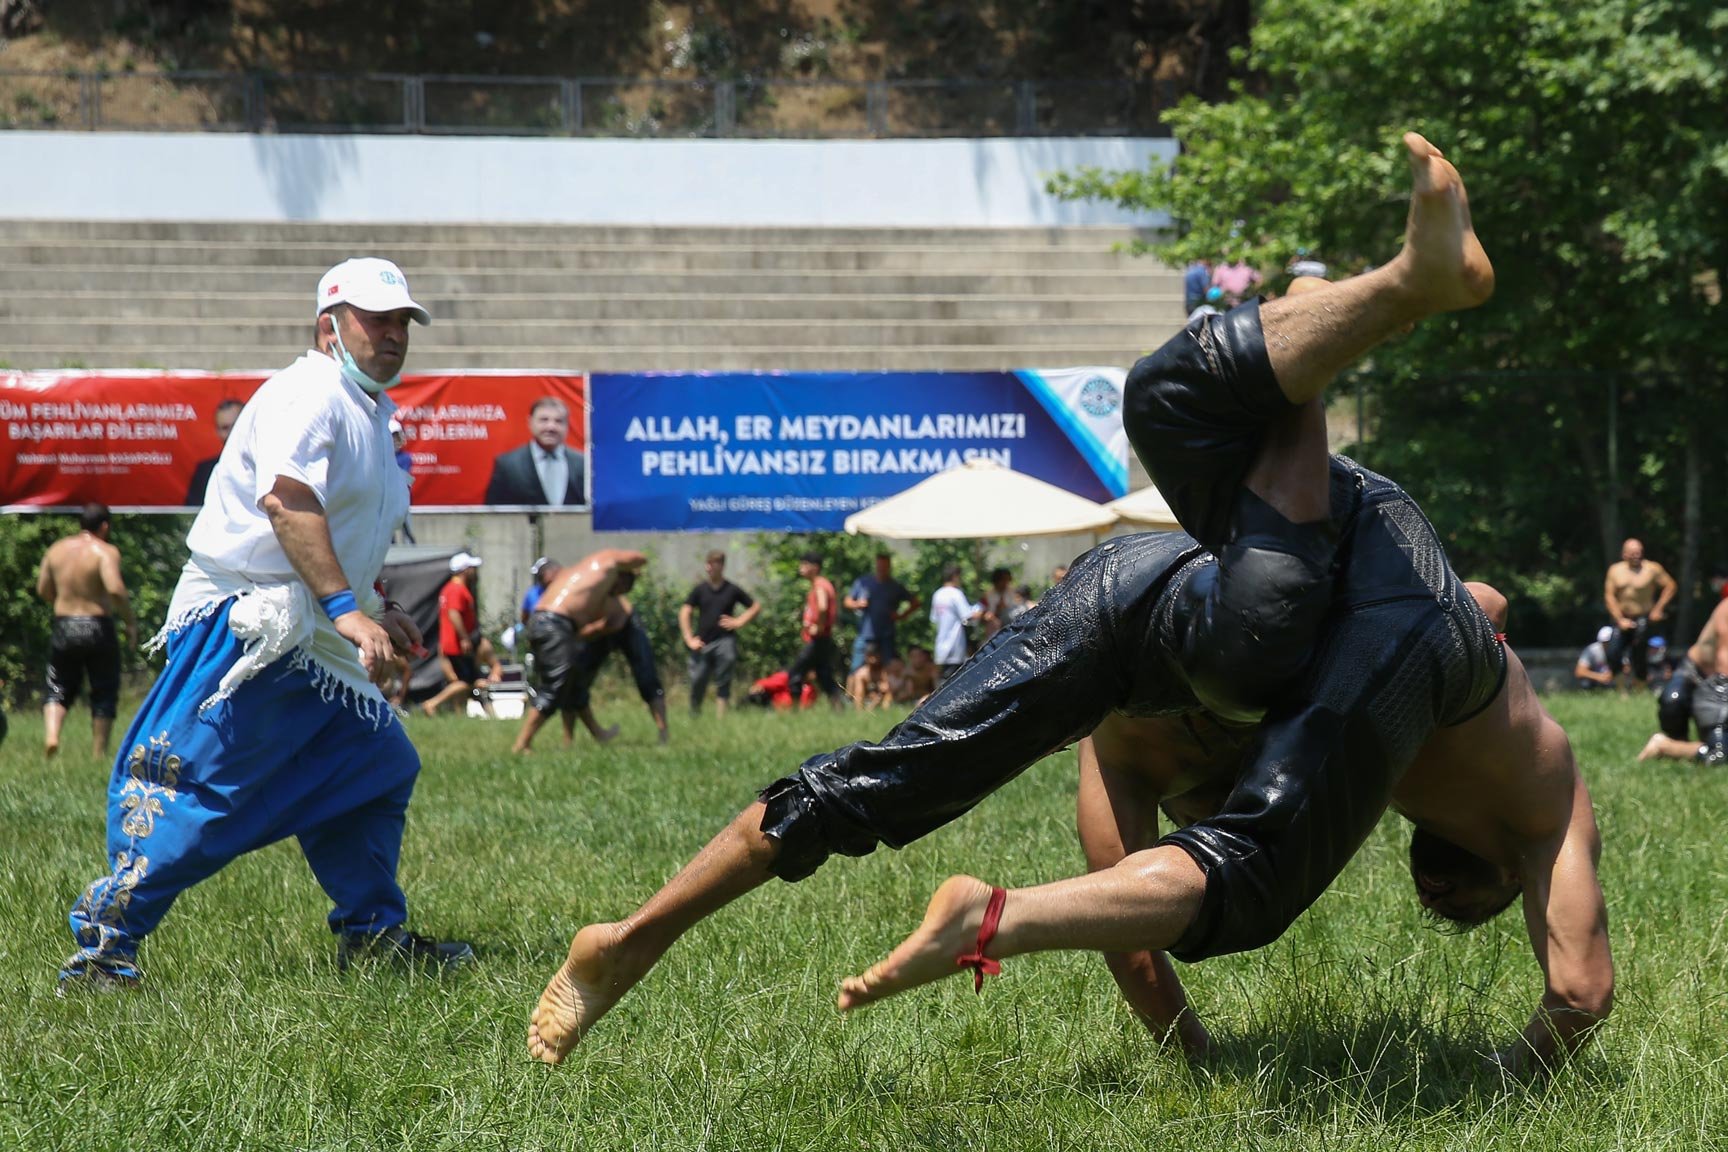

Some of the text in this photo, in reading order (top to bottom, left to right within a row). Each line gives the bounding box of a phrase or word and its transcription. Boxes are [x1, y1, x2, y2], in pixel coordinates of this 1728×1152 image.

[0, 400, 27, 420] ÜM
[8, 420, 178, 442] BAŞARILAR DİLERİM
[419, 421, 488, 440] DİLERİM
[625, 414, 1025, 445] ALLAH, ER MEYDANLARIMIZI
[641, 444, 826, 476] PEHLİVANSIZ
